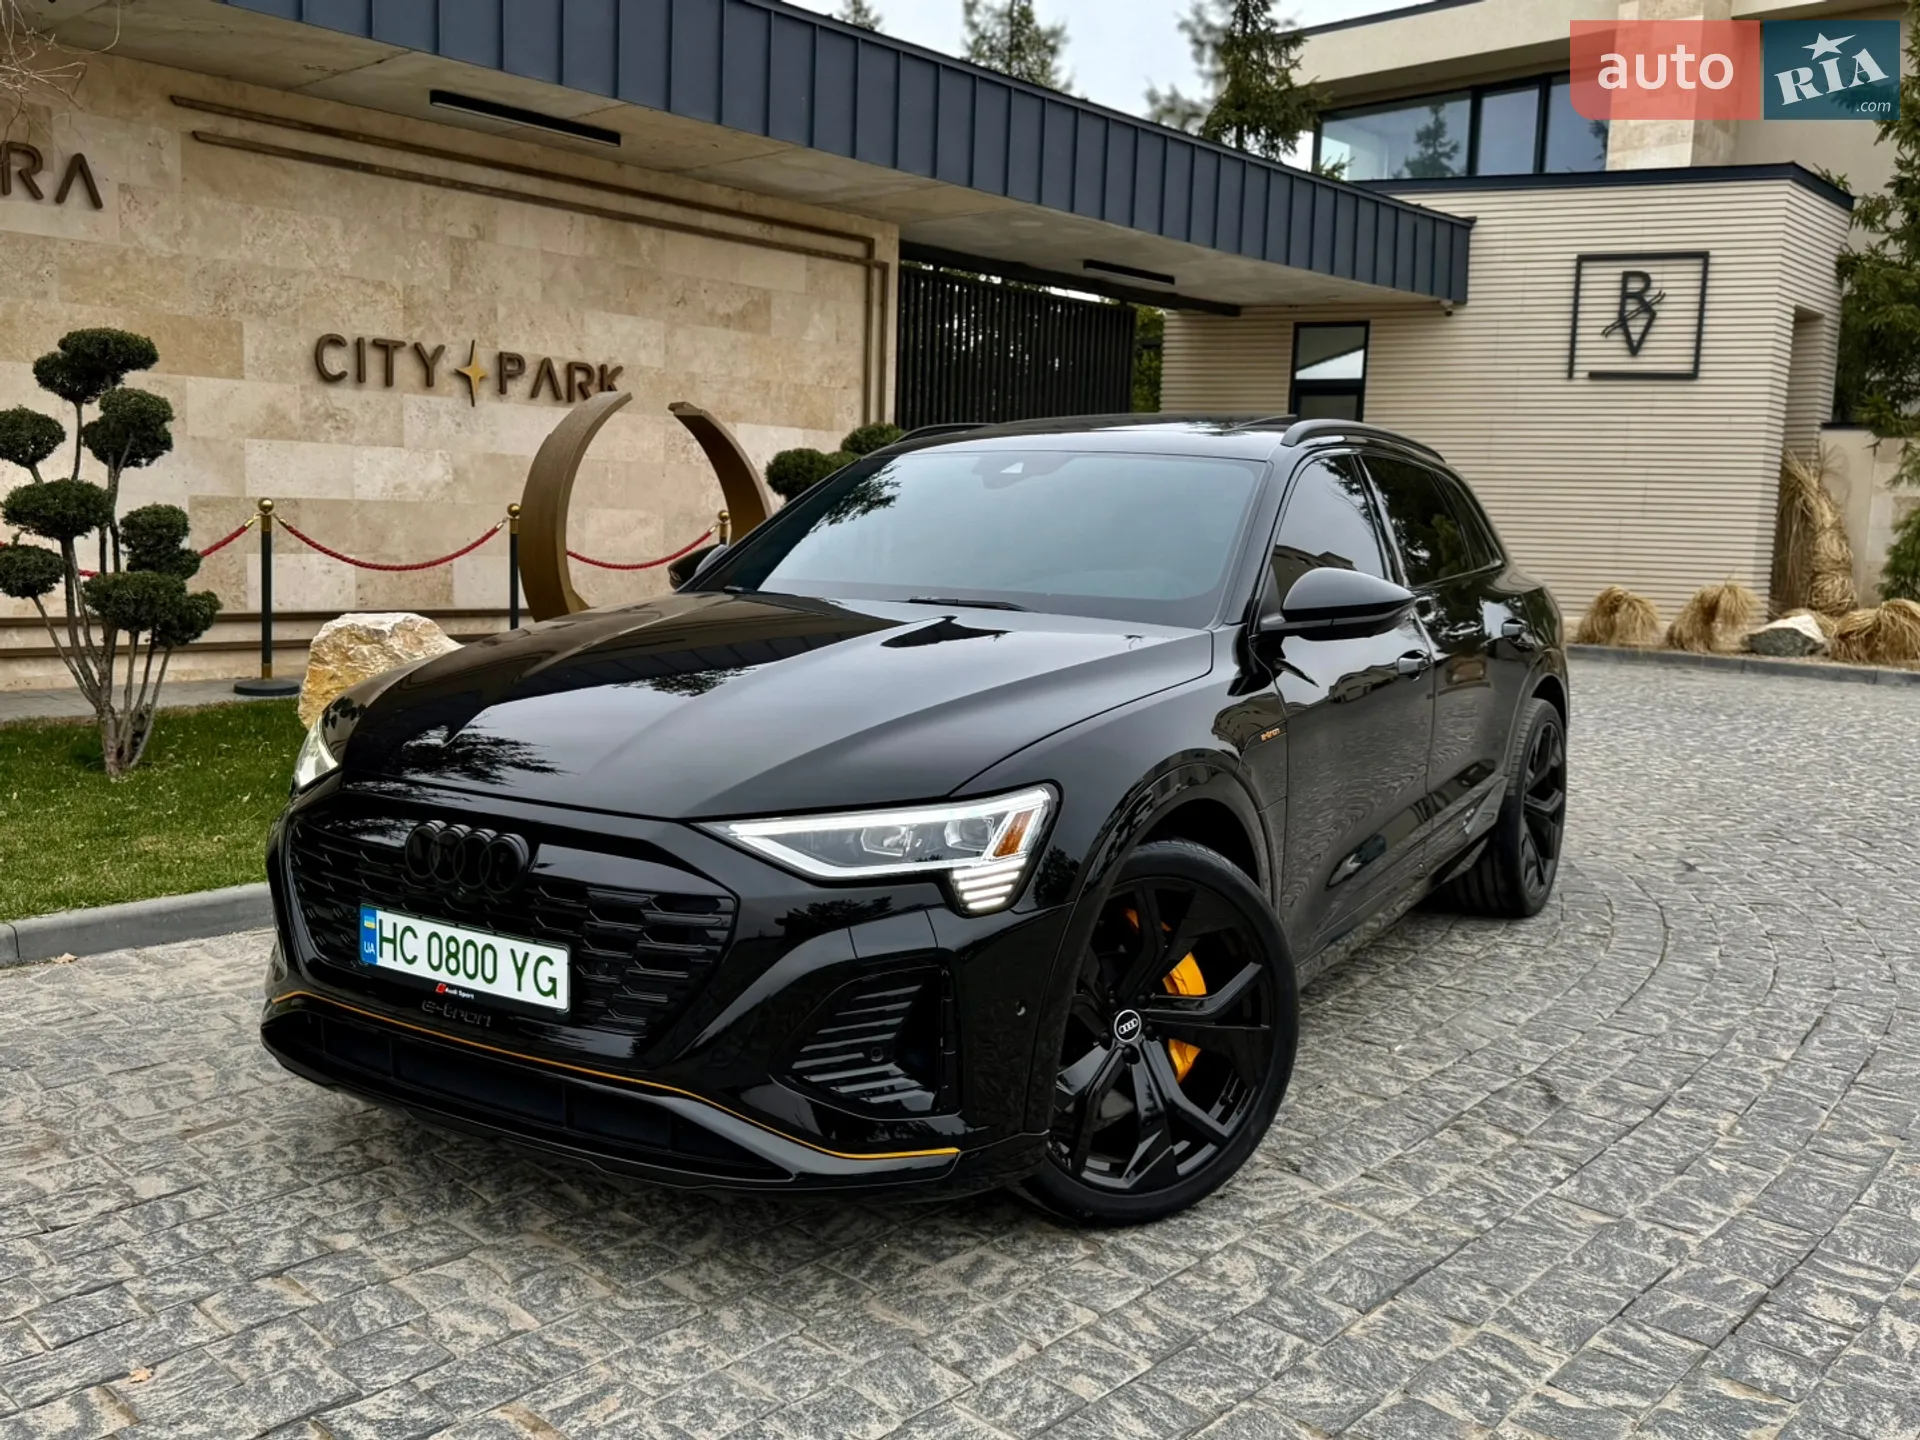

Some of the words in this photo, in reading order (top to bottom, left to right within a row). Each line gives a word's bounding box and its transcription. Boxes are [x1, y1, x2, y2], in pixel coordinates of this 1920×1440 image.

[314, 333, 446, 388] CITY
[498, 351, 624, 403] PARK
[363, 941, 376, 956] UA
[378, 919, 418, 966] HC
[427, 931, 498, 985] 0800
[510, 948, 558, 1000] YG
